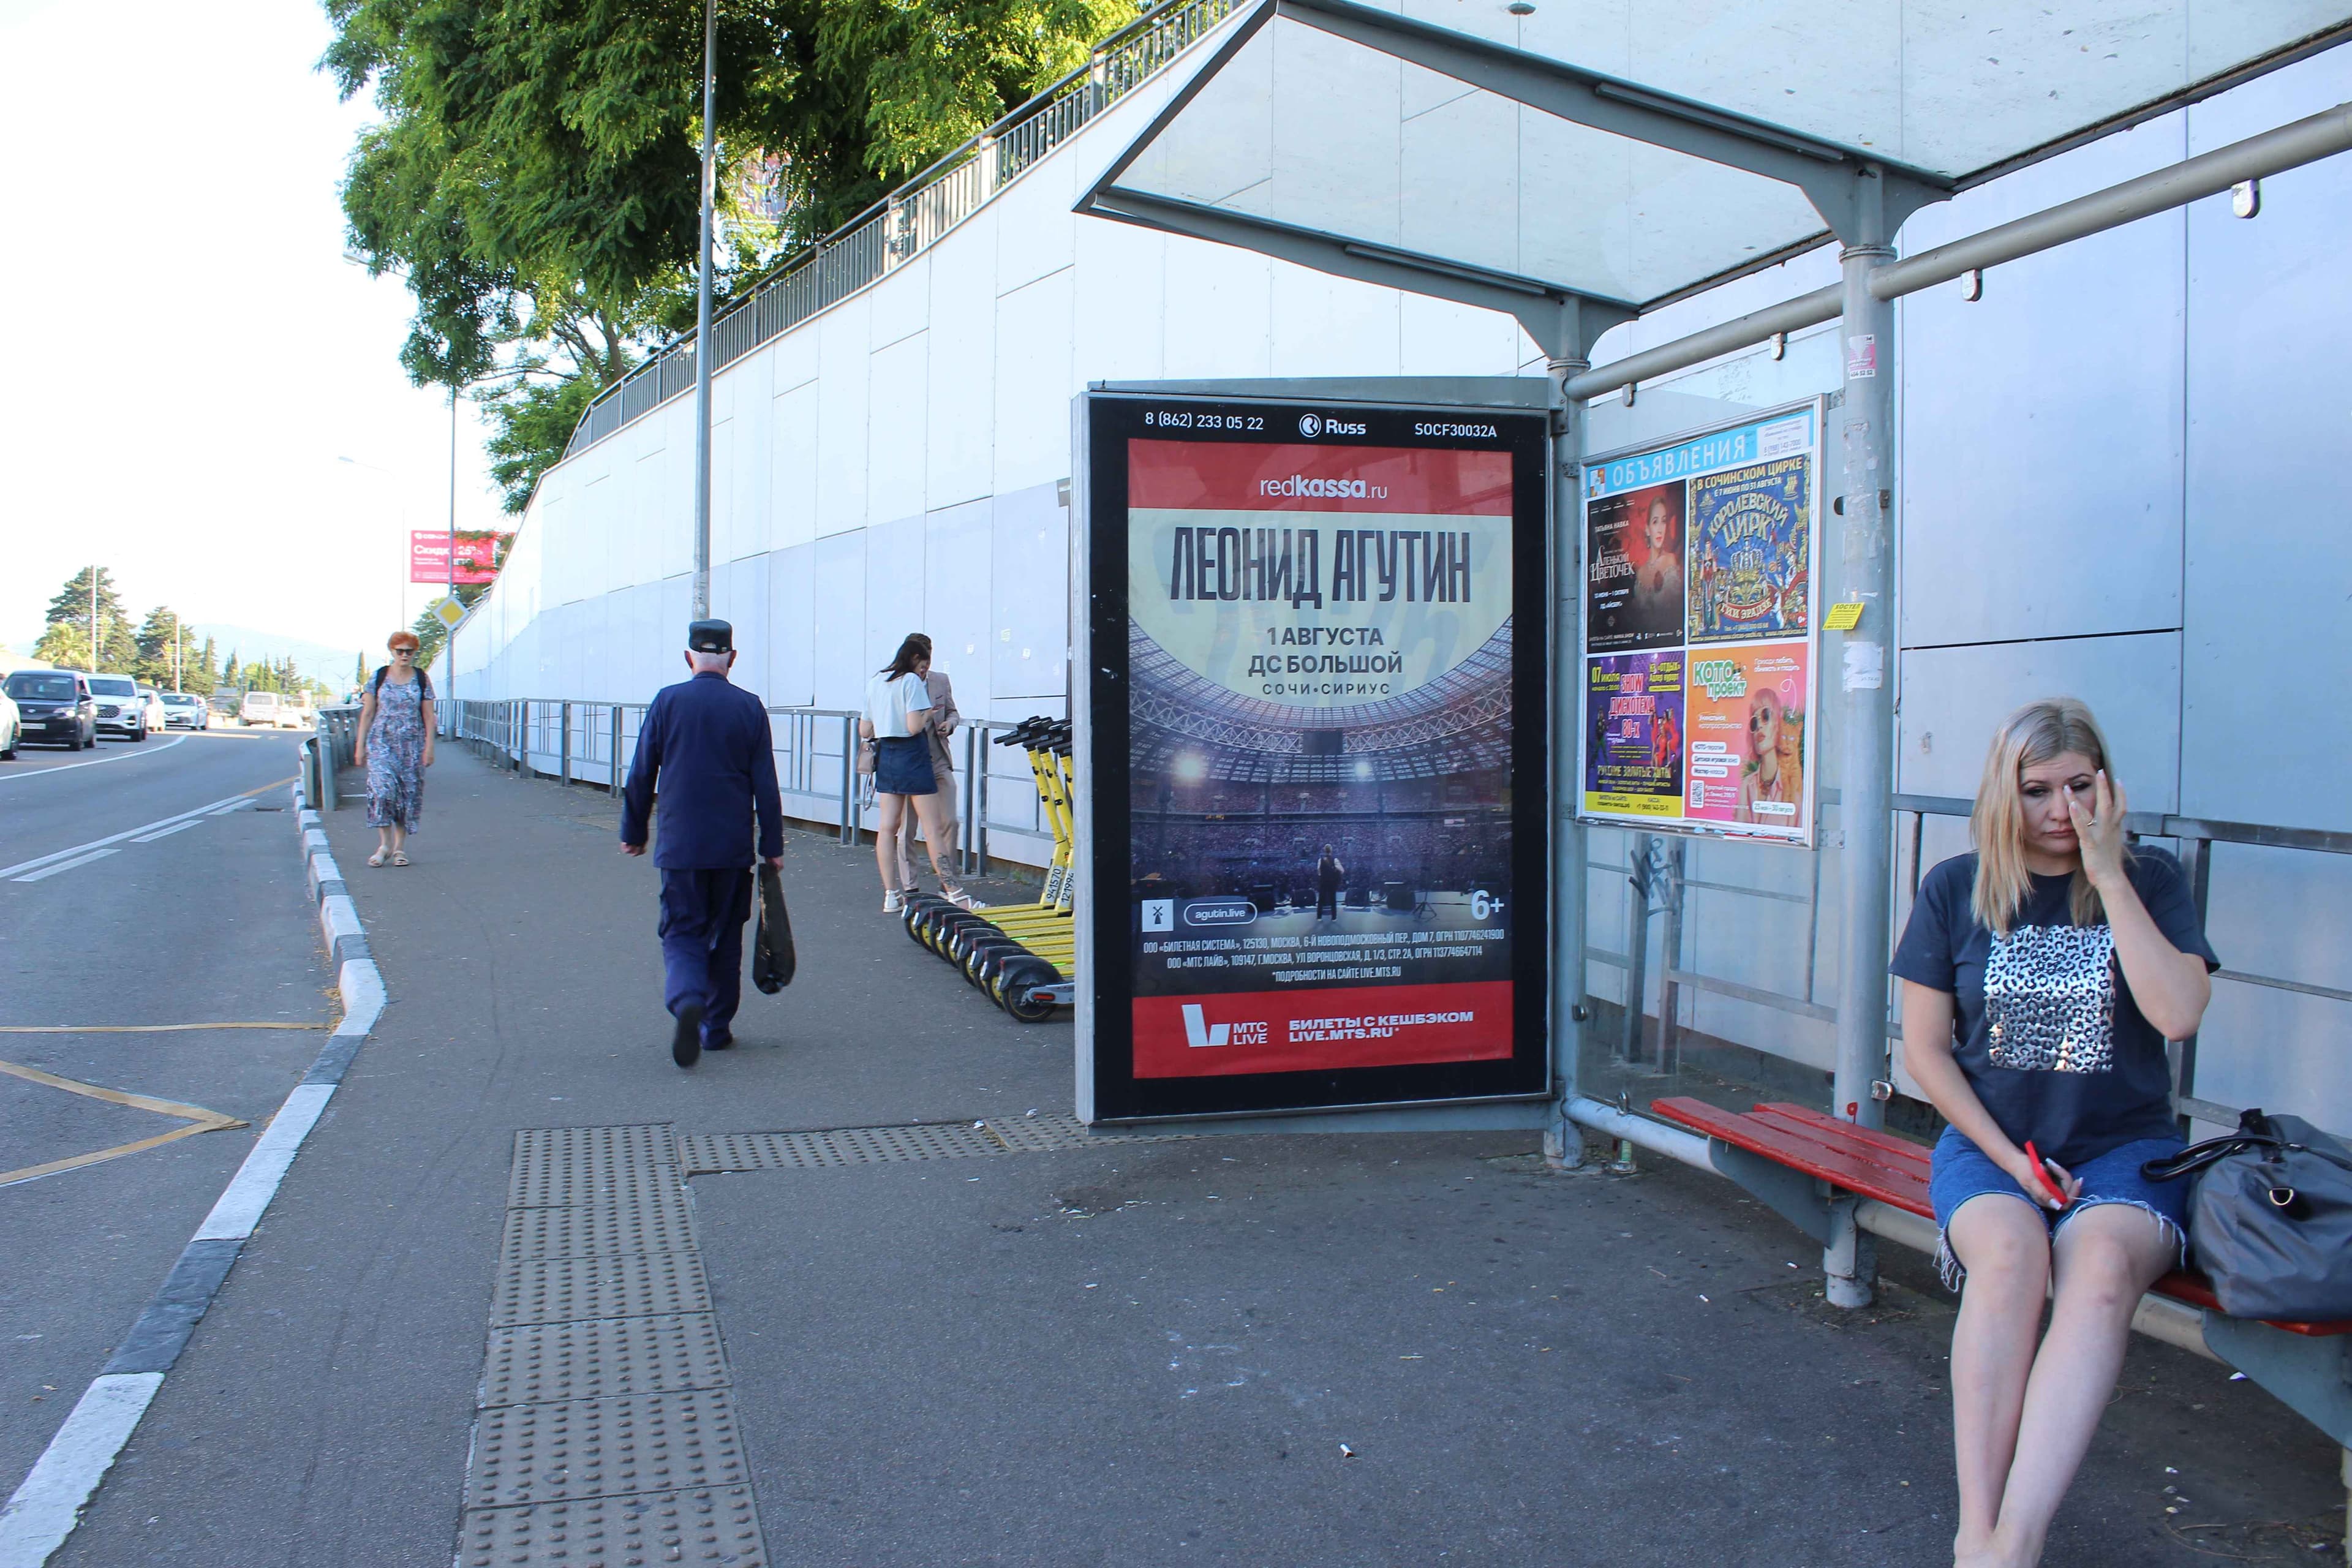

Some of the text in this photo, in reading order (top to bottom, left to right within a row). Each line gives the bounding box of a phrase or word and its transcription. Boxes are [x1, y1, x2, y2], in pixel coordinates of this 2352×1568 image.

[1145, 412, 1264, 430] 8 (862) 233 05 22
[1325, 419, 1366, 435] Russ
[1415, 423, 1497, 438] SOCF30032A
[1613, 435, 1745, 488] ОБЪЯВЛЕНИЯ
[1697, 457, 1803, 491] В СОЧИНСКОМ ЦИРКЕ
[1757, 477, 1782, 489] АВГУСТА
[1260, 475, 1388, 500] redkassa.ru
[1708, 492, 1789, 538] КОРОЛЕВСКИЙ
[1722, 512, 1772, 548] ЦИРК
[1170, 527, 1470, 609] ЛЕОНИД АГУТИН
[1267, 627, 1384, 646] 1 АВГУСТА
[1248, 650, 1402, 677] ДС БОЛЬШОЙ
[1693, 659, 1735, 686] КОТО
[1592, 666, 1602, 683] 07
[1621, 673, 1643, 693] SHOW
[1706, 681, 1747, 702] проект
[1608, 696, 1655, 720] ДИСКОТЕКА
[1046, 868, 1061, 899] 941570
[1195, 909, 1245, 921] agutin.live
[1471, 890, 1504, 921] 6+
[1144, 942, 1158, 953] ООО
[1159, 939, 1201, 953] «БИЛЕТНАЯ
[1201, 938, 1242, 952] СИСТЕМА»,
[1243, 938, 1270, 950] 125130,
[1271, 937, 1303, 949] МОСКВА,
[1303, 935, 1317, 947] 6-Й
[1317, 931, 1394, 947] НОВОПОДМОСКОВНЫЙ
[1412, 931, 1428, 944] ДОМ
[1429, 931, 1435, 943] 7,
[1436, 930, 1453, 942] ОГРН
[1167, 957, 1181, 968] ООО
[1182, 956, 1202, 968] «МТС
[1203, 954, 1230, 968] ЛАЙВ»,
[1231, 954, 1257, 967] 109147,
[1258, 952, 1294, 965] Г.МОСКВА,
[1306, 949, 1362, 964] ВОРОНЦОВСКАЯ,
[1363, 949, 1372, 962] Д.
[1373, 949, 1387, 961] 1/3,
[1415, 947, 1432, 959] ОГРН
[1327, 968, 1336, 979] НА
[1337, 966, 1360, 979] САЙТЕ
[1360, 966, 1401, 978] LIVE.MTS.RU
[1289, 1011, 1474, 1031] БИЛЕТЫ С КЕШБЭКОМ
[1234, 1033, 1268, 1046] LIVE
